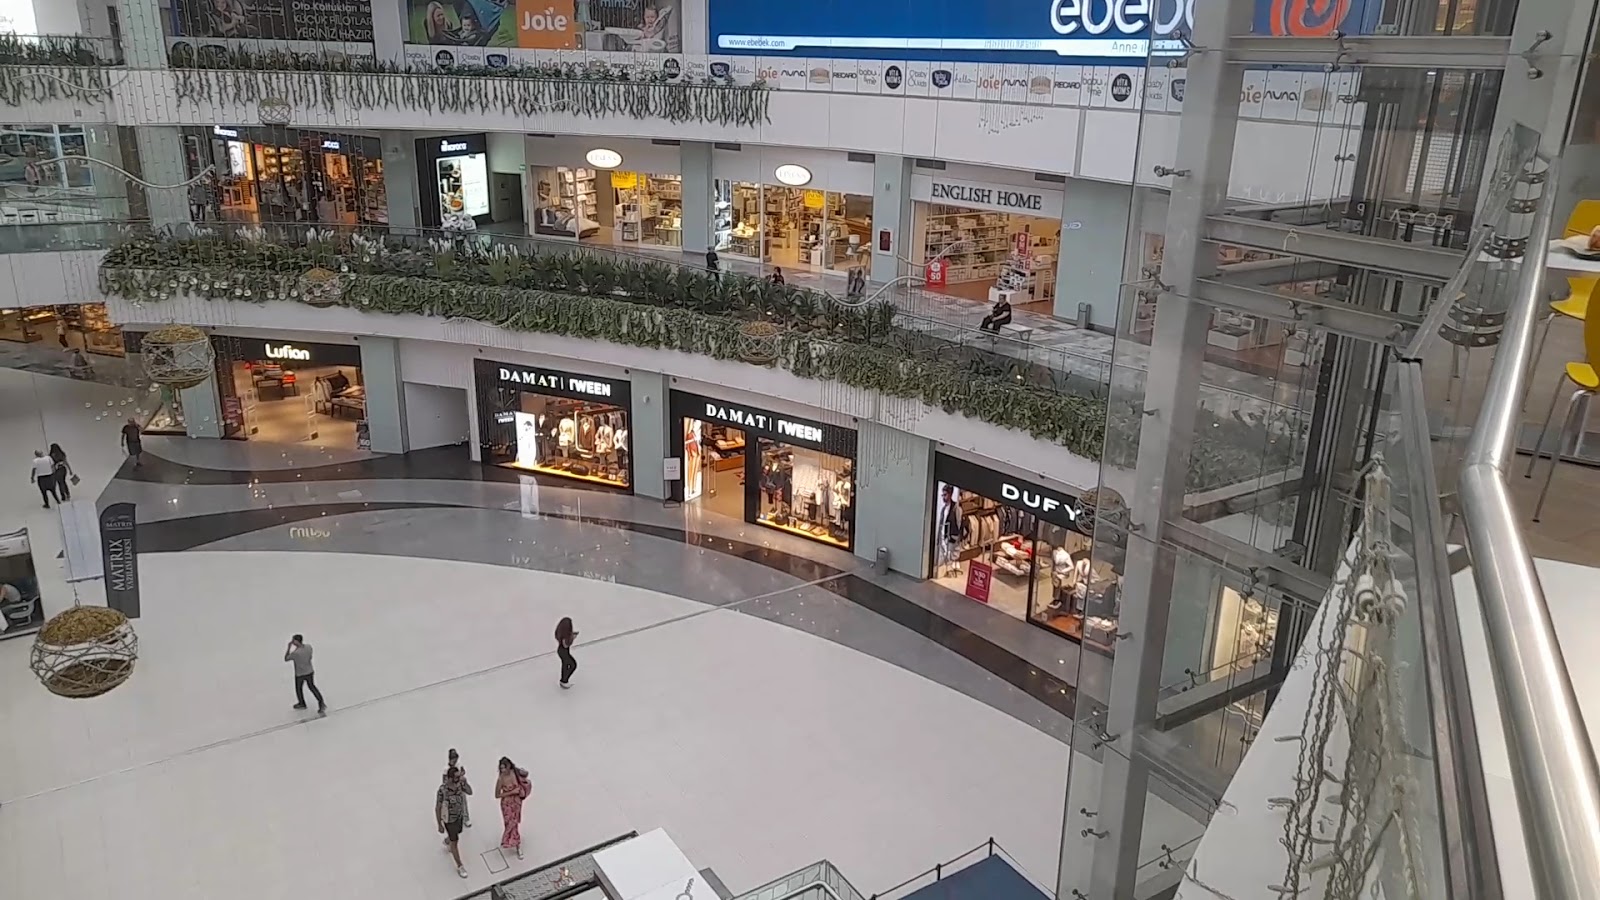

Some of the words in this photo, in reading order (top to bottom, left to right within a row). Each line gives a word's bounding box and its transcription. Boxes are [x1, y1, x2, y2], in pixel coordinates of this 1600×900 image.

[521, 7, 568, 32] Joie
[728, 38, 786, 47] www.ebebek.com
[1111, 41, 1138, 53] Anne
[757, 65, 778, 80] Joie
[780, 69, 806, 77] nuna
[833, 71, 858, 79] RECARO
[977, 74, 1000, 89] Joie
[1002, 79, 1028, 87] nuna
[1054, 81, 1081, 89] RECARO
[1264, 89, 1299, 101] nuna
[931, 183, 993, 205] ENGLISH
[996, 190, 1042, 210] HOME
[930, 272, 942, 280] 50
[264, 343, 311, 361] Lufian
[499, 368, 559, 389] DAMAT
[705, 403, 767, 429] DAMAT
[1001, 482, 1083, 521] DUFY
[105, 520, 134, 529] MATRIX
[109, 538, 126, 592] MATRIX
